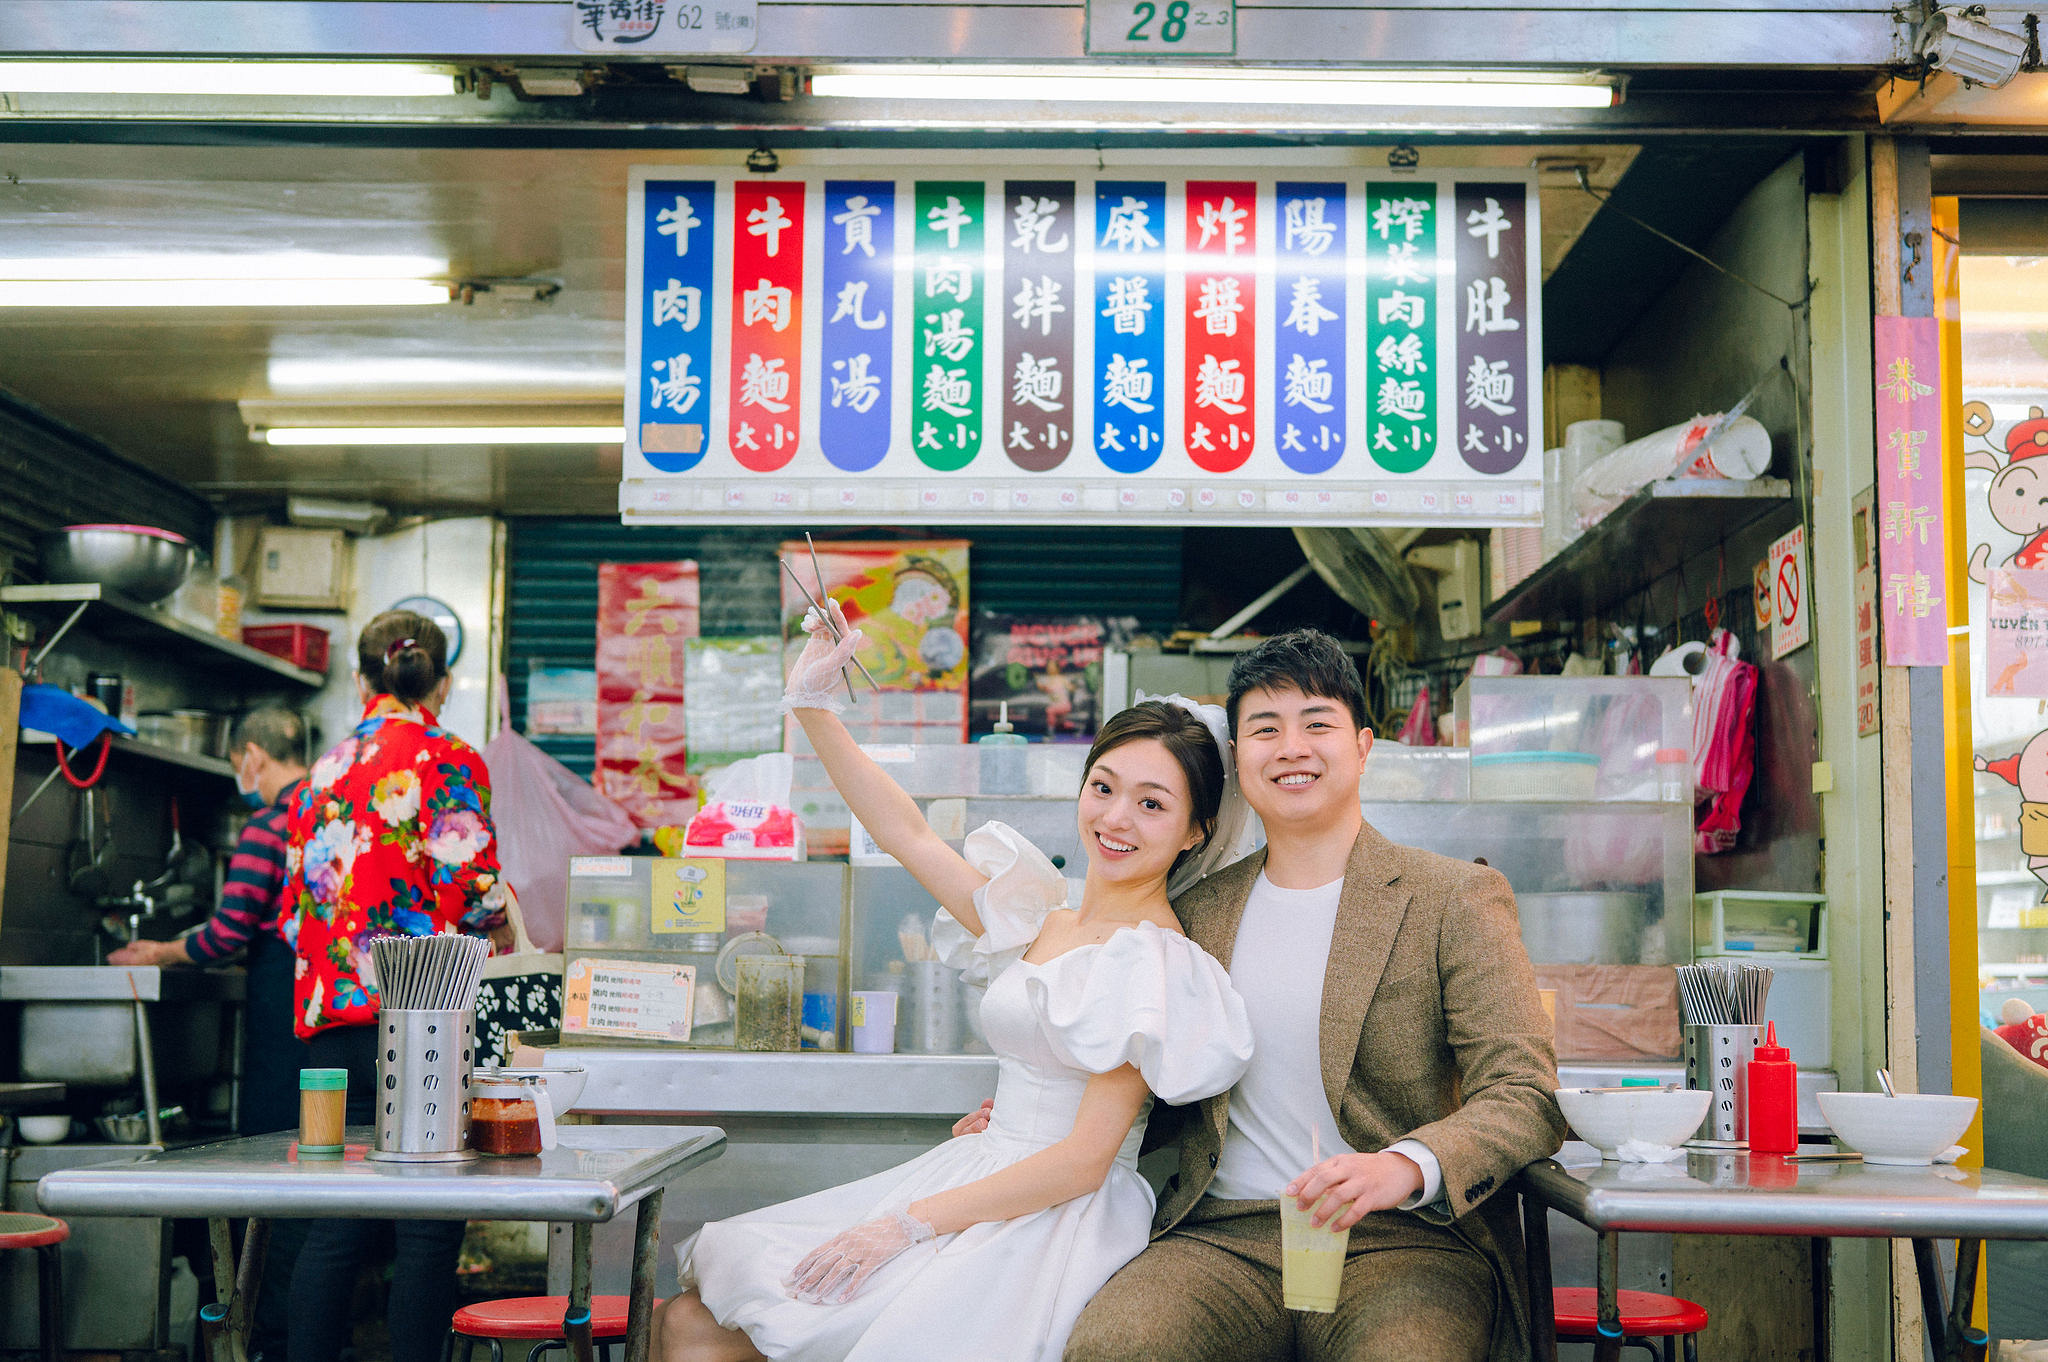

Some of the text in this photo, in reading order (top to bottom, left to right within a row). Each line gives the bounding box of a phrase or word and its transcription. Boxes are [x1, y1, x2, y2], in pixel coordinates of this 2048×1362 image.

[651, 196, 701, 414] 牛肉湯
[739, 196, 792, 413] 牛肉麵
[830, 196, 886, 414] 貢丸湯
[922, 196, 975, 418] 牛肉湯麵
[1011, 196, 1069, 412] 乾拌麵
[1101, 197, 1159, 414] 麻醬麵
[1193, 197, 1248, 414] 炸醬麵
[1283, 197, 1339, 414] 陽春麵
[1372, 197, 1431, 421] 榨菜肉絲麵
[1465, 197, 1520, 416] 牛肚麵
[1878, 357, 1941, 619] 恭賀新禧
